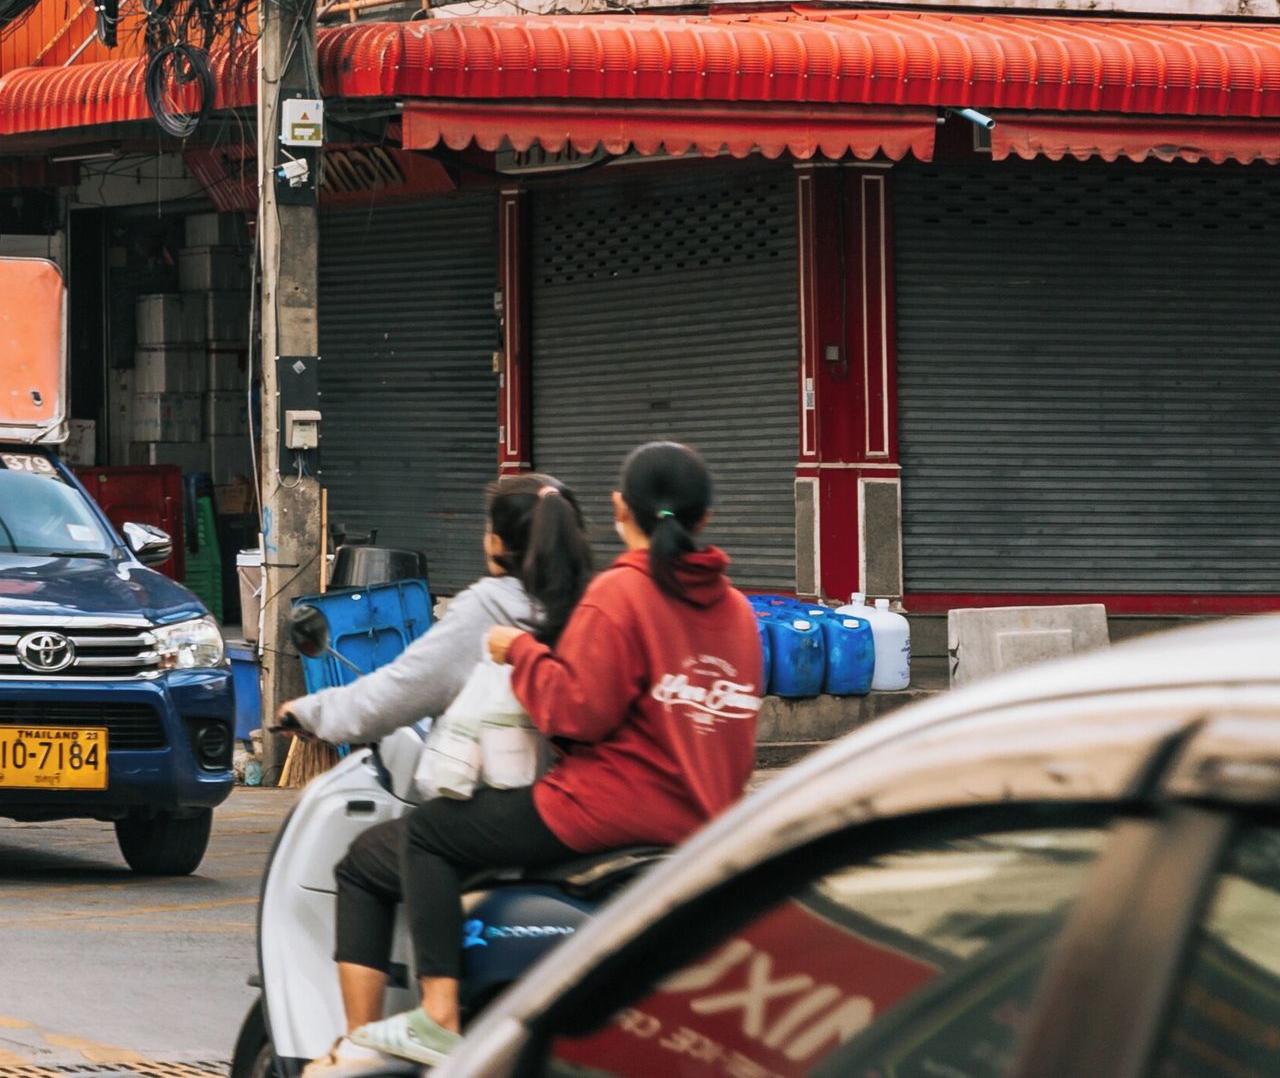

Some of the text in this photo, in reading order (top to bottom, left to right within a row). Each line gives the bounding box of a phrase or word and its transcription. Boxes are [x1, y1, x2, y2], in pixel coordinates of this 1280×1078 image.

[1, 455, 52, 472] 379
[17, 730, 79, 740] THAILAND
[2, 739, 99, 771] 10-7184
